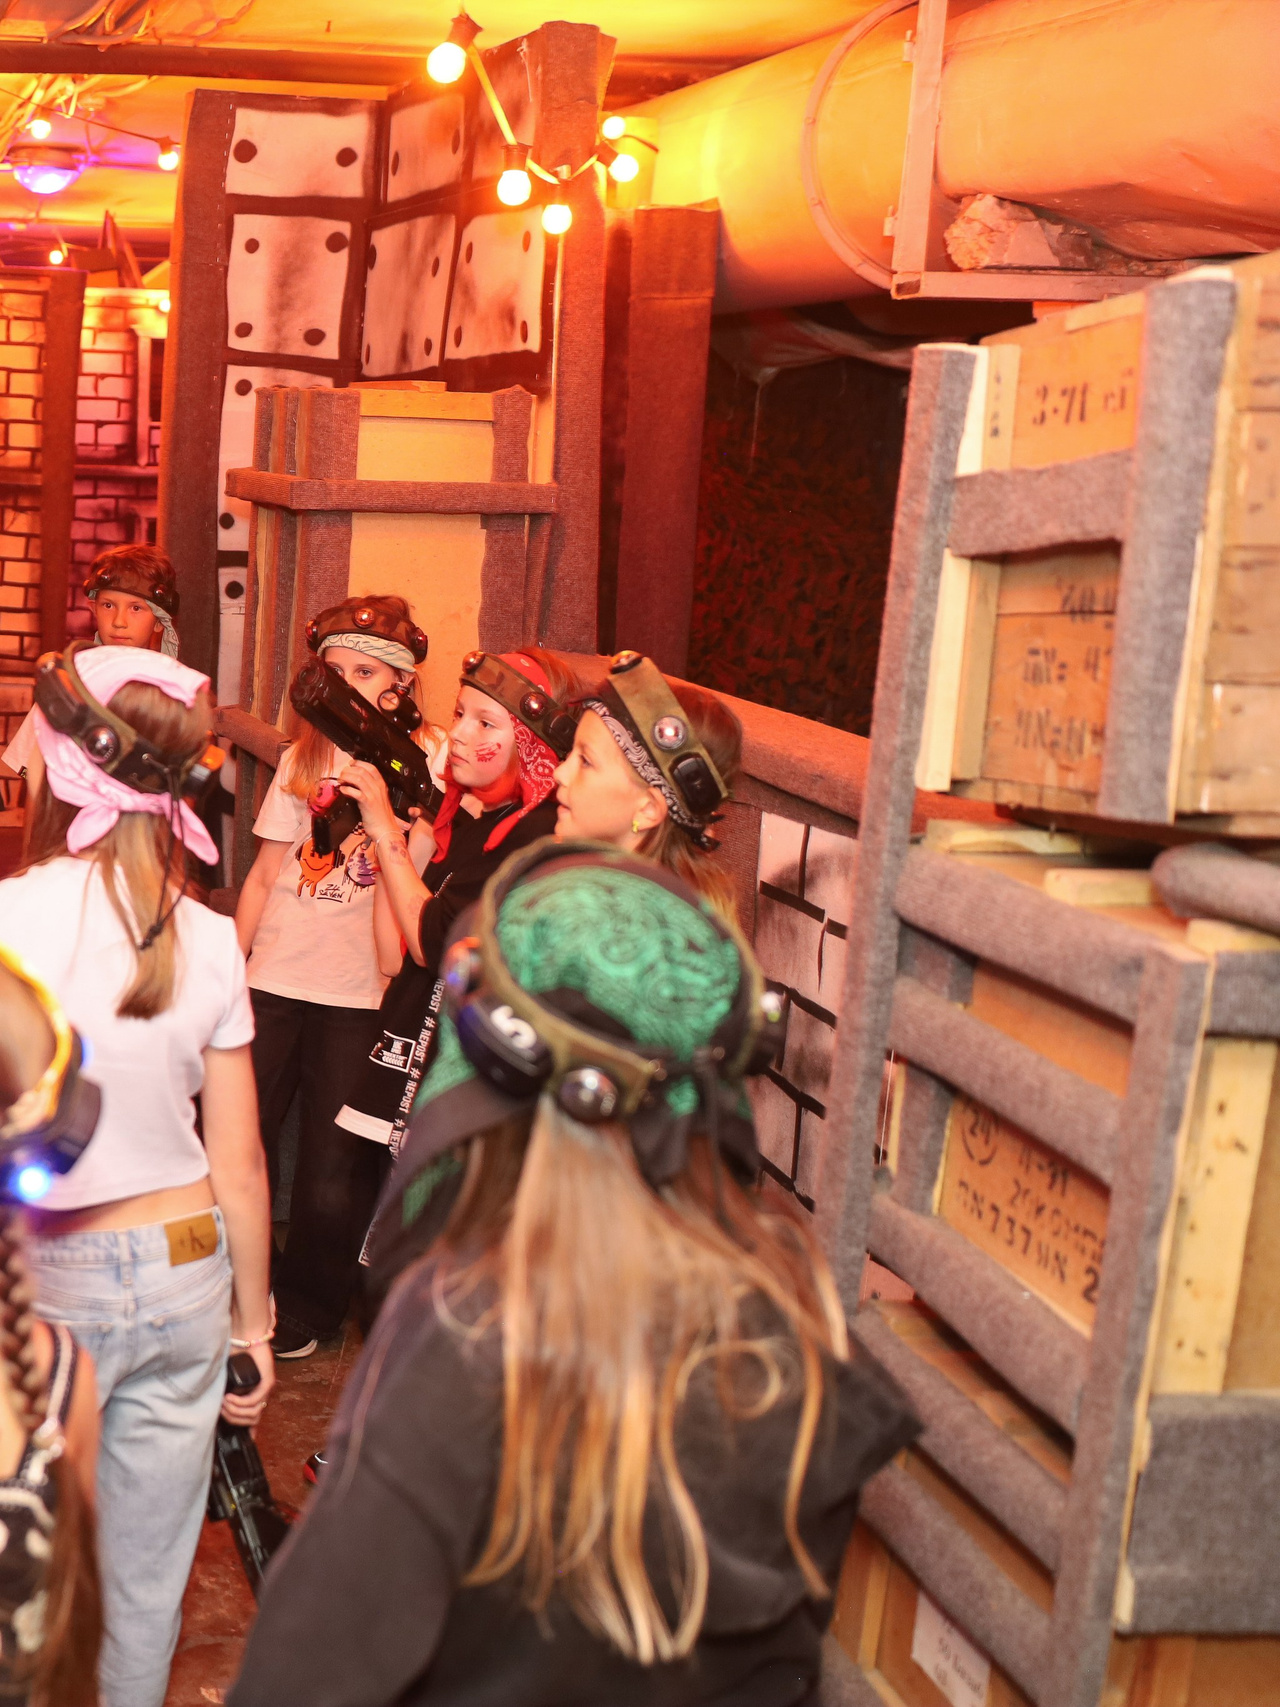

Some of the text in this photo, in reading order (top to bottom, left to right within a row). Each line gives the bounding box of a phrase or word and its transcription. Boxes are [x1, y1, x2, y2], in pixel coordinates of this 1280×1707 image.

[429, 979, 446, 1012] REPOST
[414, 1028, 433, 1063] REPOST
[399, 1079, 417, 1113] REPOST
